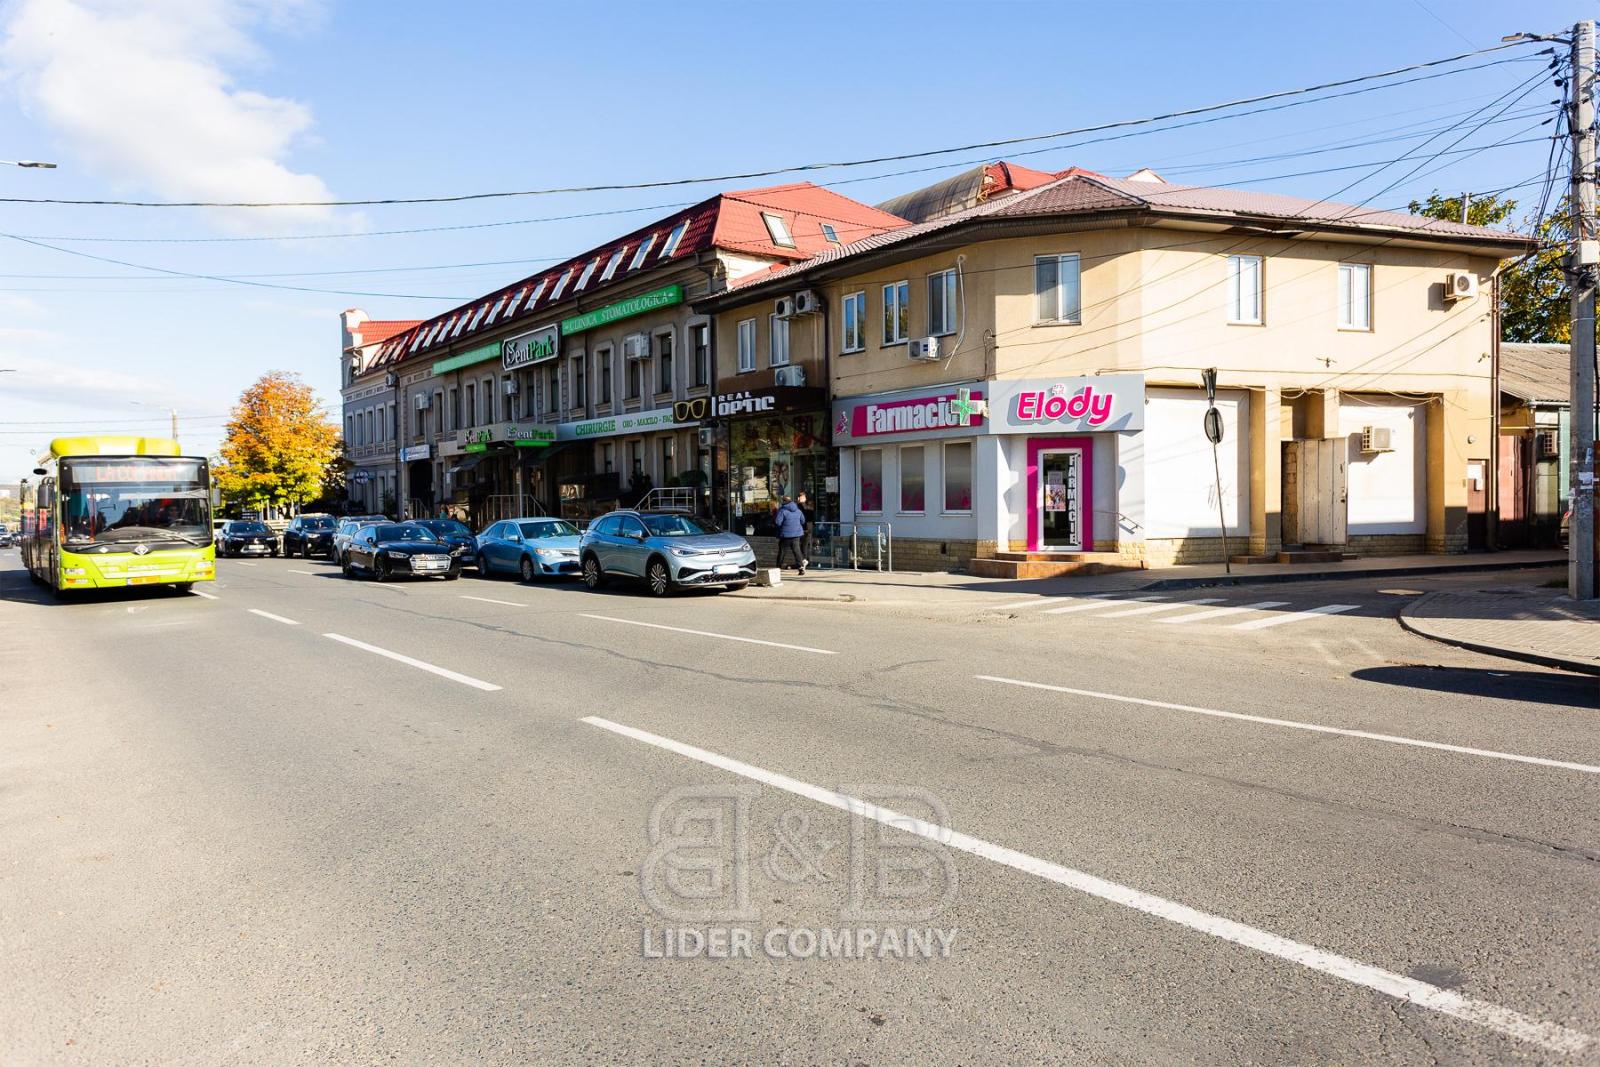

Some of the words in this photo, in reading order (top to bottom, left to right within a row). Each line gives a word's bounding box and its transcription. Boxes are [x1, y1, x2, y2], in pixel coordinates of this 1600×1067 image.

[569, 313, 598, 331] CLINICA
[506, 336, 557, 368] DentPark
[718, 391, 752, 402] REAL
[718, 396, 775, 416] OPTIC
[1017, 385, 1113, 426] Elody
[575, 419, 616, 436] CHIRURGIE
[1067, 455, 1077, 544] FARMACIE
